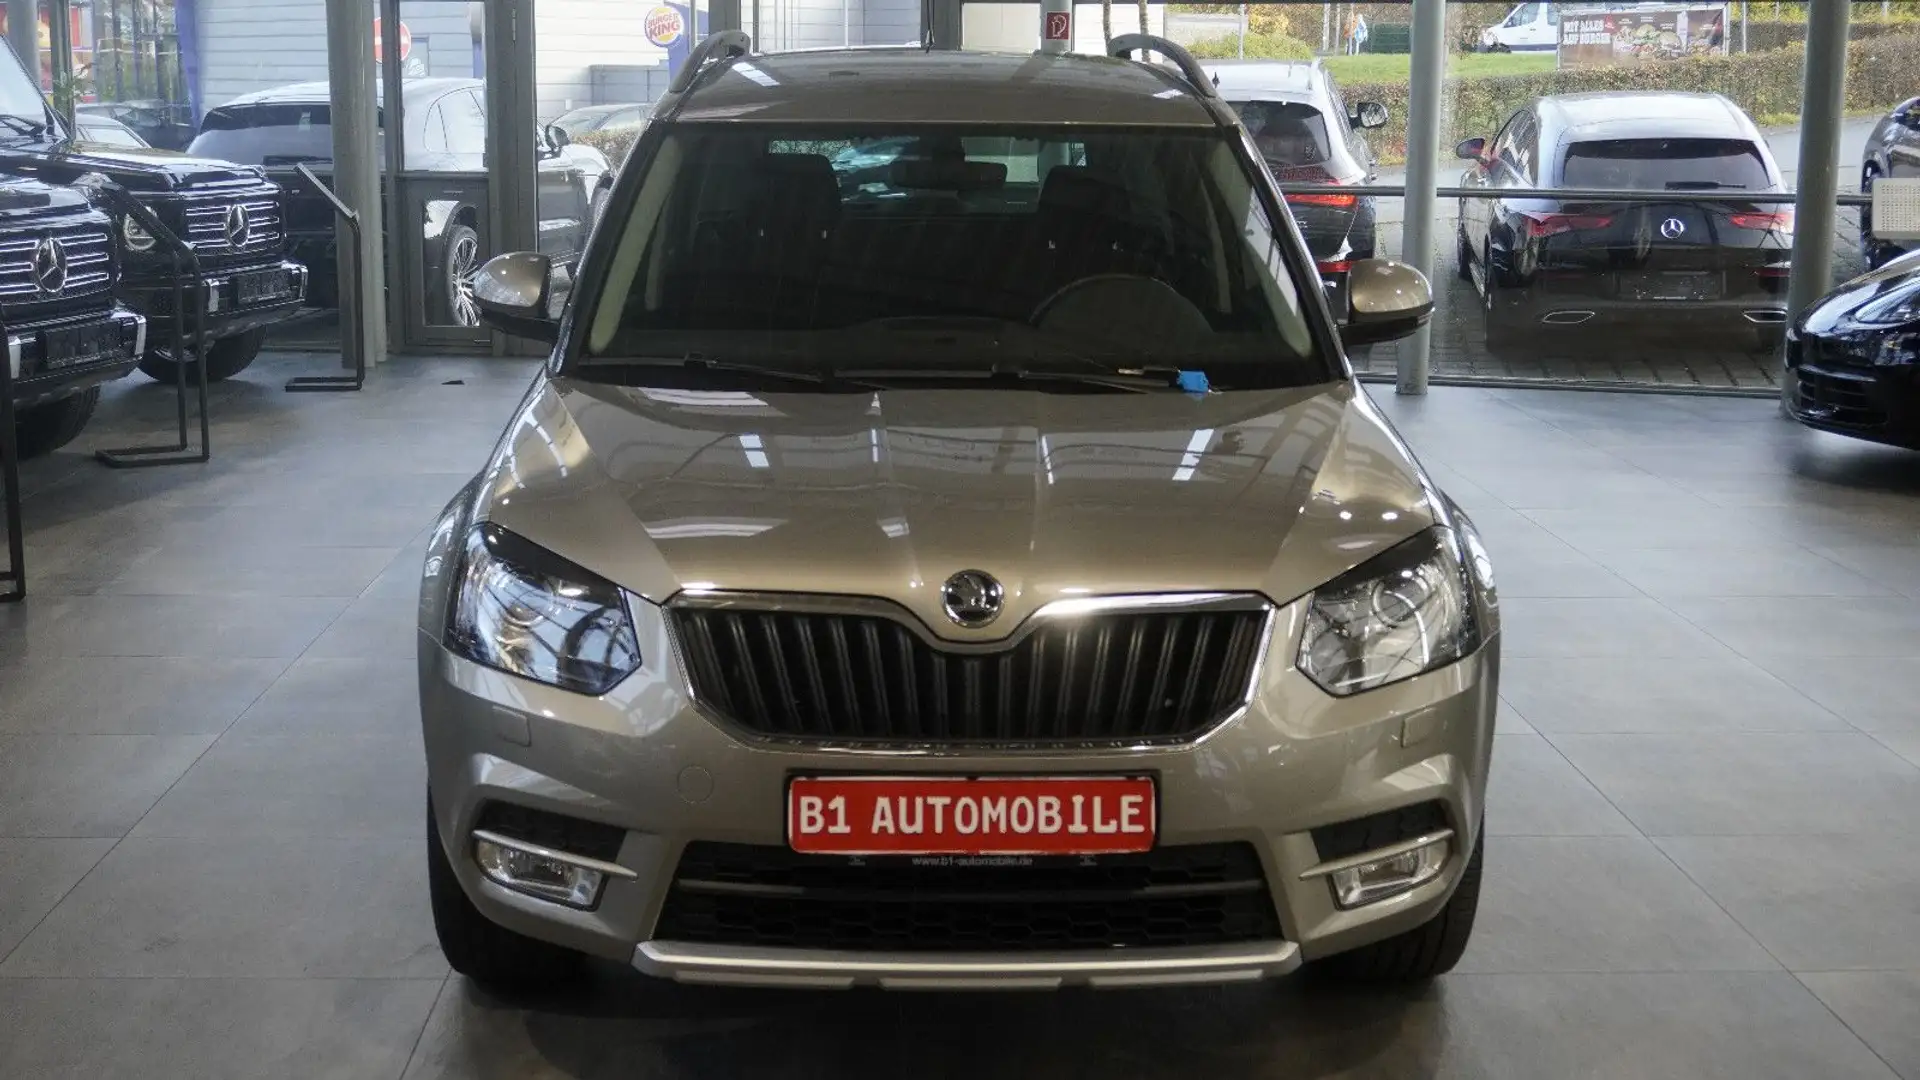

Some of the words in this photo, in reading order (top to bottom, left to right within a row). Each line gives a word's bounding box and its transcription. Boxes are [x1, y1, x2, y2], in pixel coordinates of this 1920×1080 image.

[648, 13, 680, 28] BURGER
[649, 21, 680, 36] KING
[800, 795, 851, 833] B1
[871, 795, 1144, 834] AUTOMOBILE
[911, 855, 1033, 867] www.b1-automobile.de
